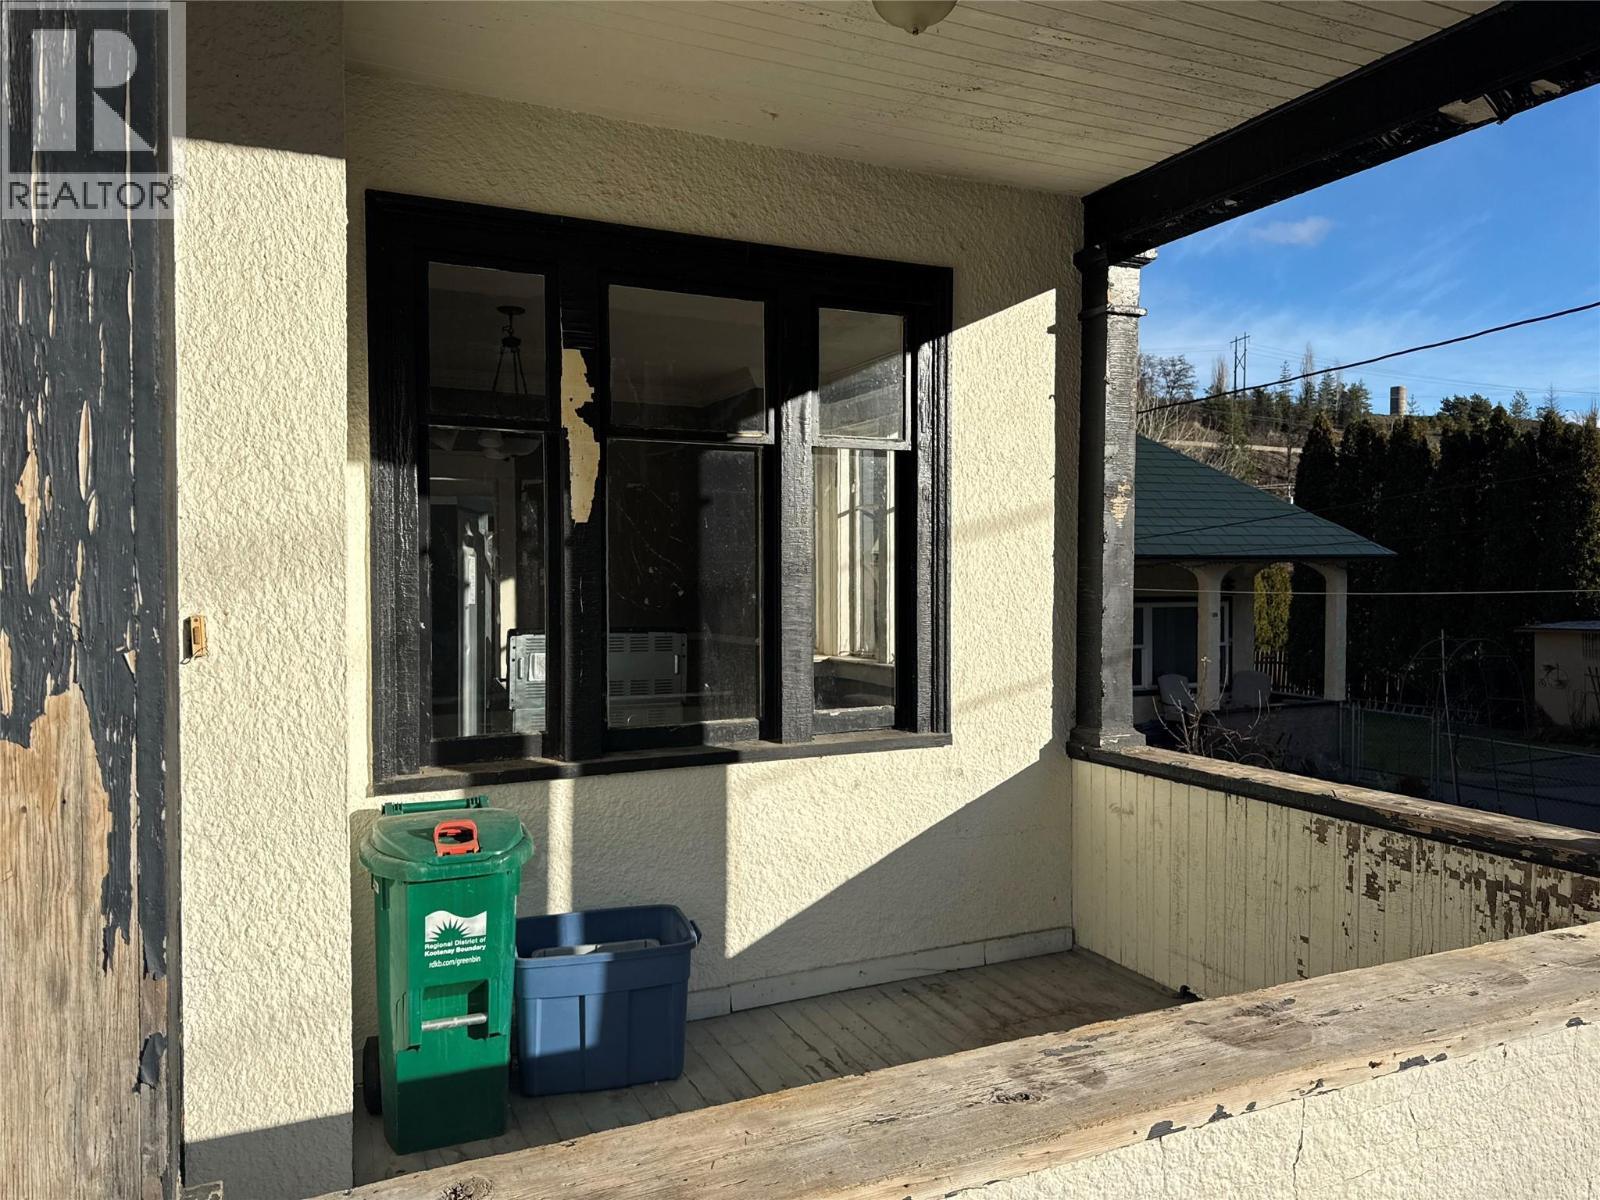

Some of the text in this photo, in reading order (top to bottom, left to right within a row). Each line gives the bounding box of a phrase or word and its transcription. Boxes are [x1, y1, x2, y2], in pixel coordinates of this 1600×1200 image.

[424, 944, 486, 957] Kootenay Boundary
[425, 941, 453, 950] Regional
[454, 938, 478, 946] District
[429, 955, 481, 968] rdkb.com/greenbin
